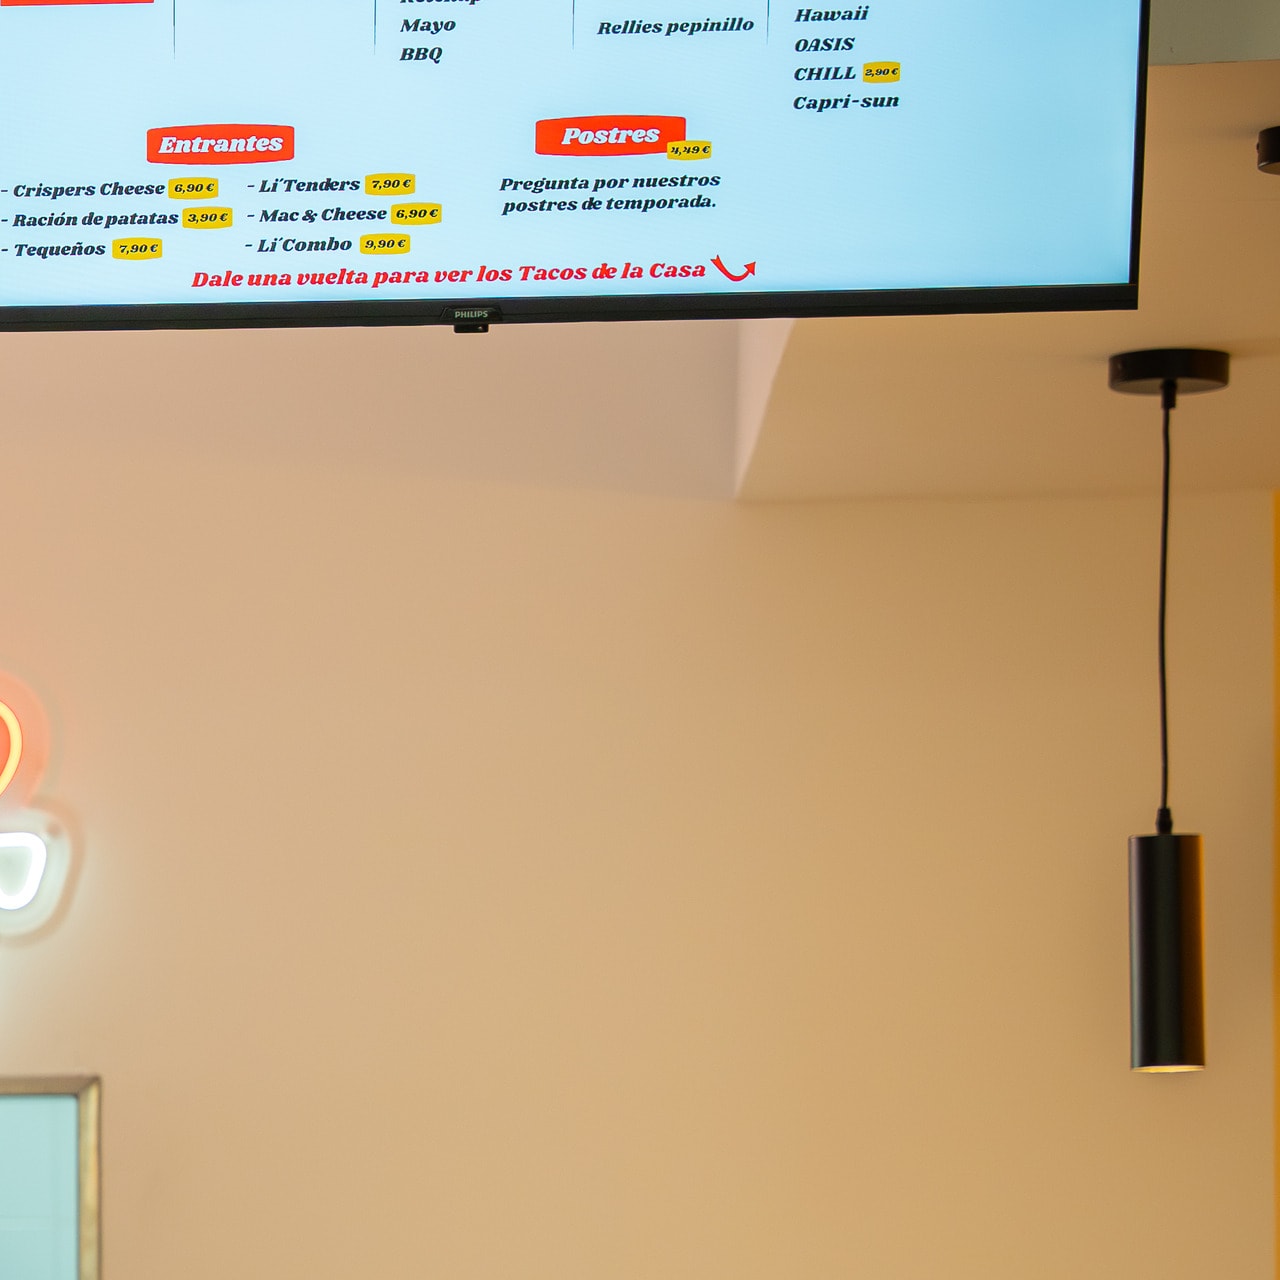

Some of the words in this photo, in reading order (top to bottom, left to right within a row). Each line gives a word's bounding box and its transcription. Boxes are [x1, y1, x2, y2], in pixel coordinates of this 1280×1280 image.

[794, 5, 870, 22] Hawaii
[400, 18, 456, 35] Mayo
[597, 19, 663, 35] Rellies
[664, 17, 755, 36] pepinillo
[794, 37, 855, 52] OASIS
[399, 46, 443, 64] BBQ
[793, 66, 857, 81] CHILL
[793, 94, 900, 113] Capri-sun
[158, 134, 283, 154] Entrantes
[561, 127, 660, 145] Postres
[13, 183, 96, 200] Crispers
[99, 181, 166, 196] Cheese
[499, 177, 589, 194] Pregunta
[592, 176, 630, 192] por
[632, 174, 721, 188] nuestros
[502, 198, 578, 216] postres
[582, 197, 603, 211] de
[606, 194, 717, 213] temporada.
[13, 211, 78, 227] Ración
[81, 212, 104, 226] de
[104, 212, 179, 229] patatas
[259, 209, 299, 223] Mac
[301, 209, 318, 223] &
[321, 207, 387, 221] Cheese
[14, 241, 106, 259] Tequeños
[191, 270, 244, 289] Dale
[247, 273, 292, 288] una
[296, 267, 369, 286] vuelta
[371, 269, 429, 289] para
[434, 268, 474, 284] ver
[476, 264, 513, 283] los
[519, 264, 587, 282] Tacos
[592, 262, 619, 280] de
[621, 261, 644, 279] la
[648, 262, 706, 279] Casa
[454, 310, 488, 319] PHILIPS
